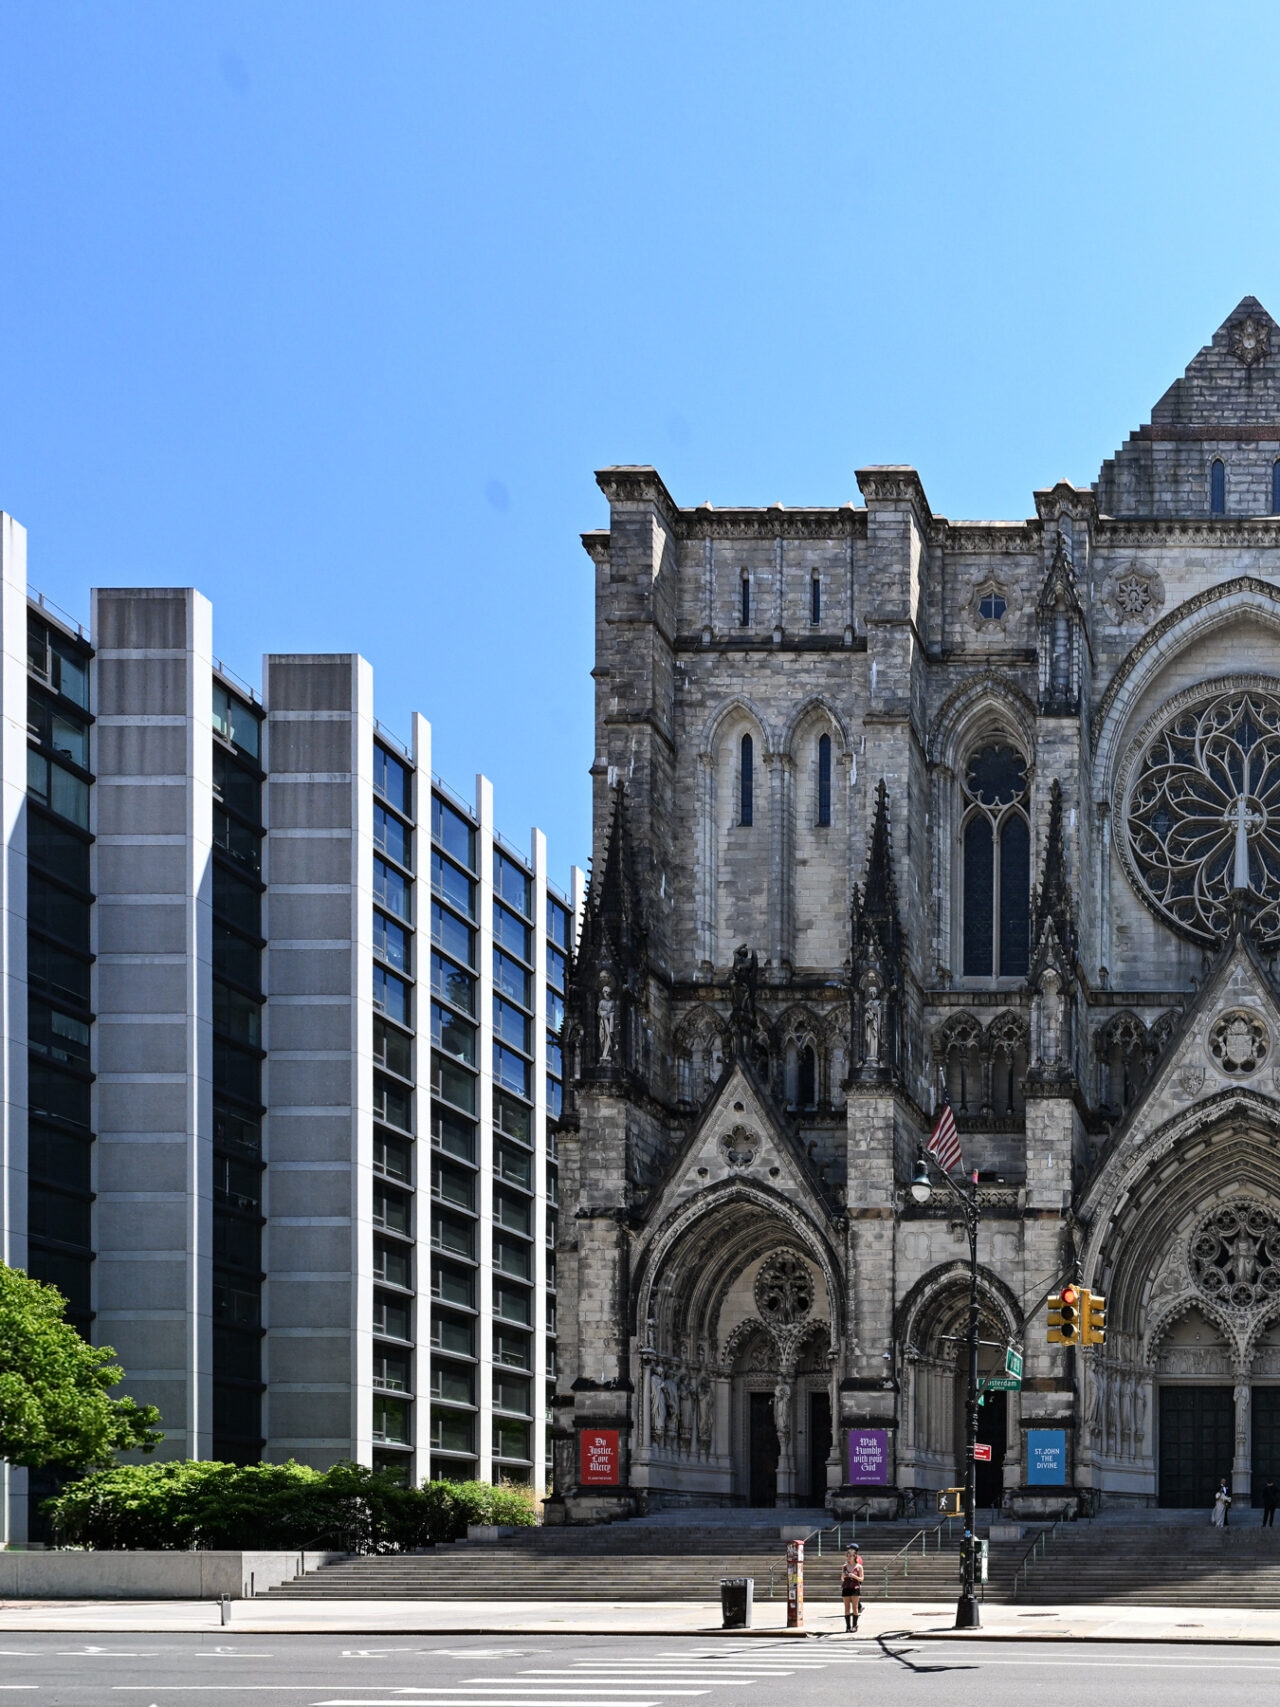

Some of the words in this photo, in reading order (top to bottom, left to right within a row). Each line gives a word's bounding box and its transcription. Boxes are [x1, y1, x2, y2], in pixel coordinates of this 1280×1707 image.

[595, 1437, 606, 1446] Do
[860, 1438, 877, 1446] Walk
[588, 1446, 613, 1456] Justice,
[592, 1455, 608, 1464] Love
[854, 1454, 869, 1463] with
[870, 1455, 883, 1464] your
[590, 1463, 611, 1473] Mercy
[861, 1463, 876, 1472] God
